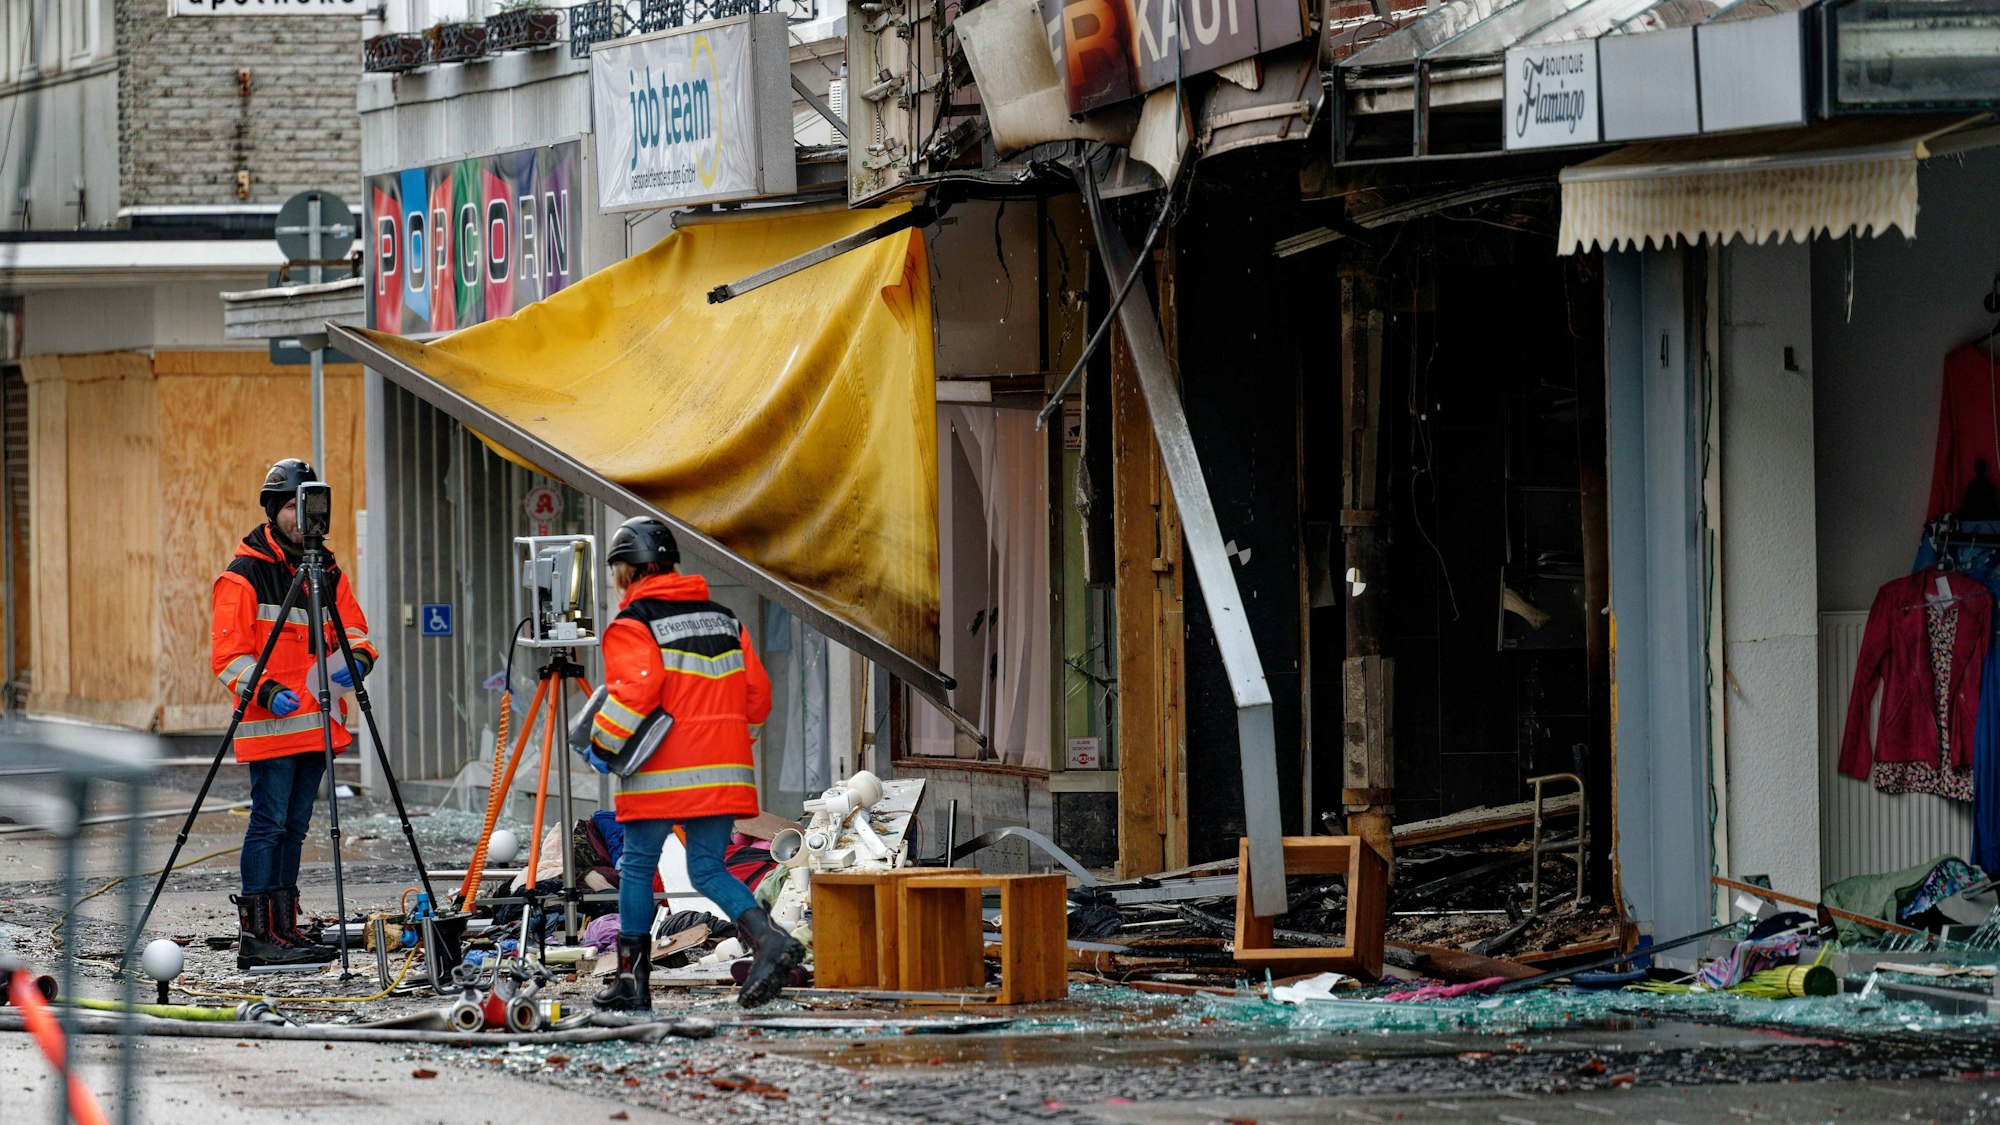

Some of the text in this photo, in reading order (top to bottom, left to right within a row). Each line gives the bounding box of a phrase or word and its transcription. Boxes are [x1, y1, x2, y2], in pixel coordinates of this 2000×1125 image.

[1545, 53, 1584, 77] BOUTIQUE
[630, 65, 711, 172] job team
[1516, 55, 1585, 139] Flamingo
[682, 162, 696, 184] GmbH
[378, 189, 570, 296] POPCORN
[1660, 333, 1669, 368] 41
